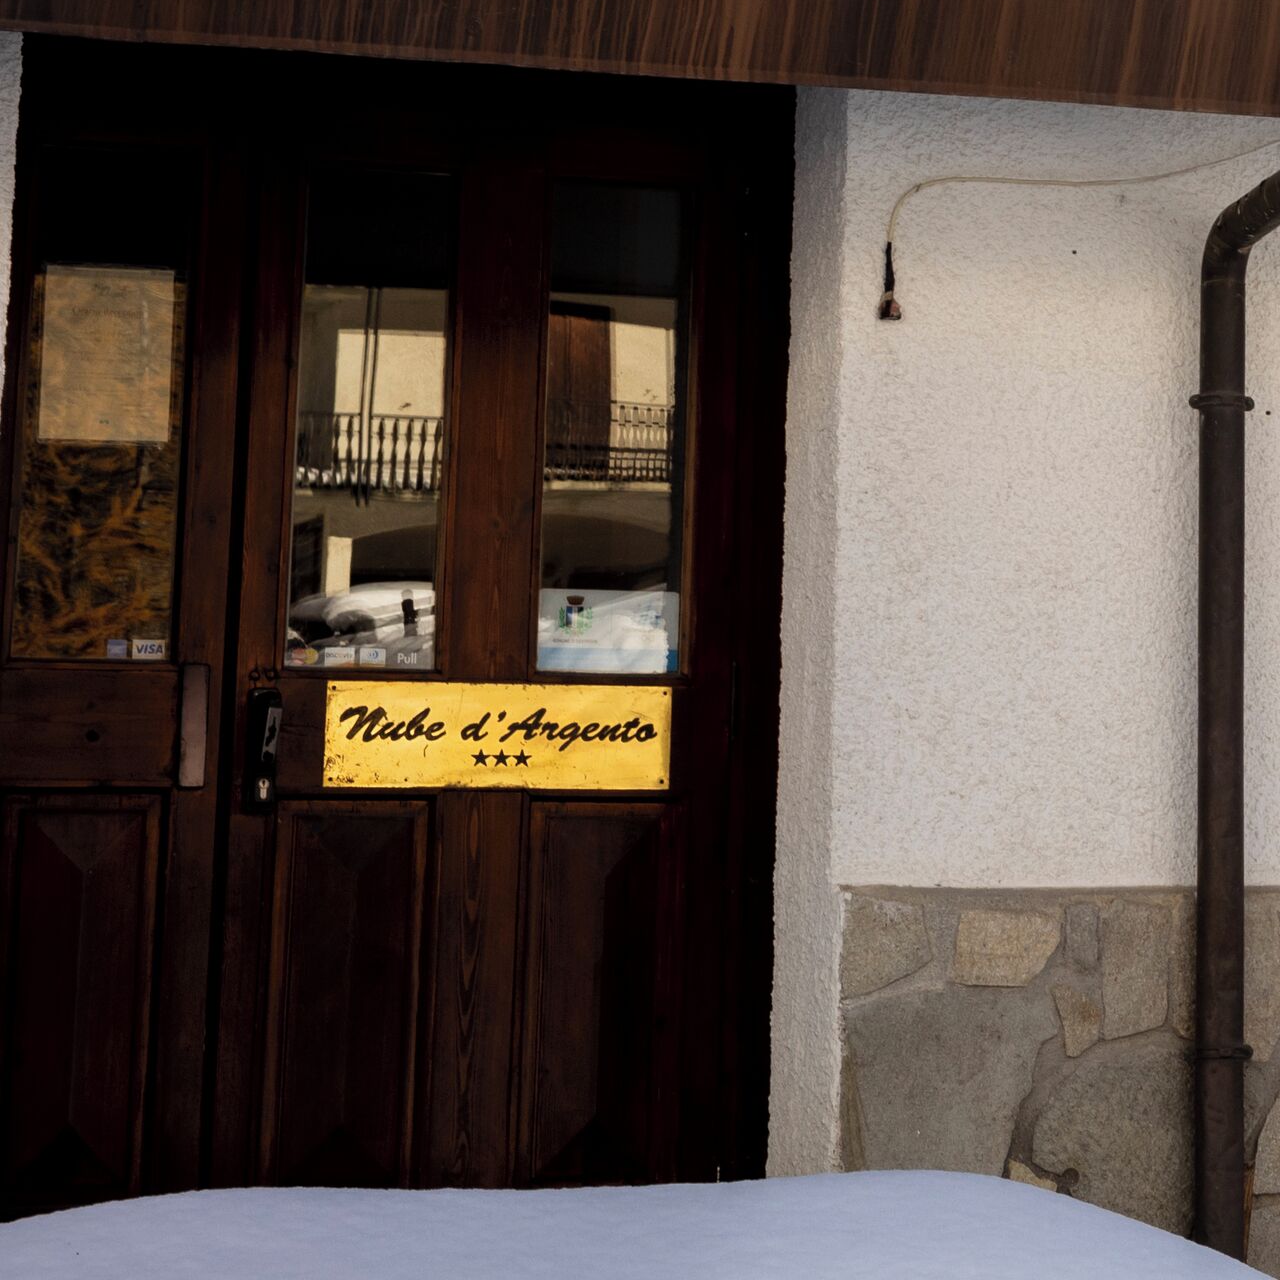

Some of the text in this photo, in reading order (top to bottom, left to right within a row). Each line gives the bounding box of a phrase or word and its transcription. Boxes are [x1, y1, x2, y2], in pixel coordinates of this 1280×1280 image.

[136, 644, 163, 654] VISA
[397, 652, 417, 665] Pull
[339, 705, 658, 752] Nube d'Argento
